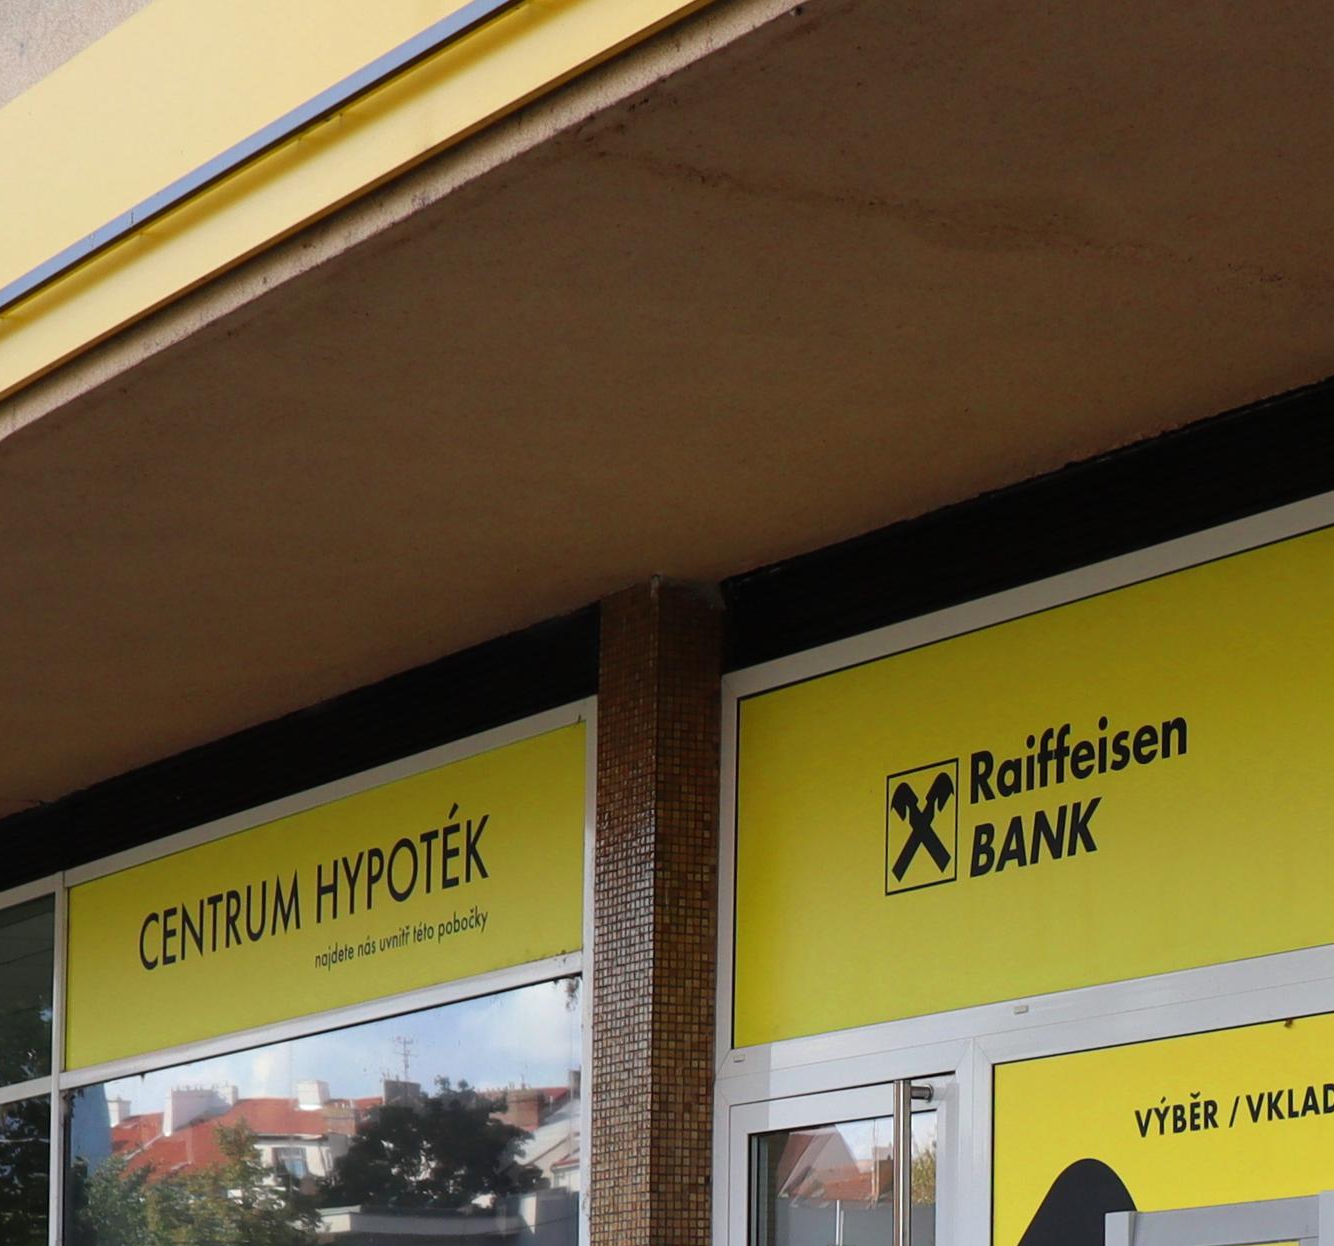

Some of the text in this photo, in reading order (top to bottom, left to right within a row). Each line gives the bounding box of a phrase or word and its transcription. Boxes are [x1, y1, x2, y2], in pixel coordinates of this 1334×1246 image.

[970, 716, 1188, 805] Raiffeisen
[969, 796, 1102, 878] BANK
[139, 802, 490, 971] CENTRUM HYPOTÉK
[315, 905, 489, 971] najdete nás uvnitř této pobočky
[1134, 1091, 1219, 1138] VÝBĚR
[1229, 1095, 1239, 1128] /
